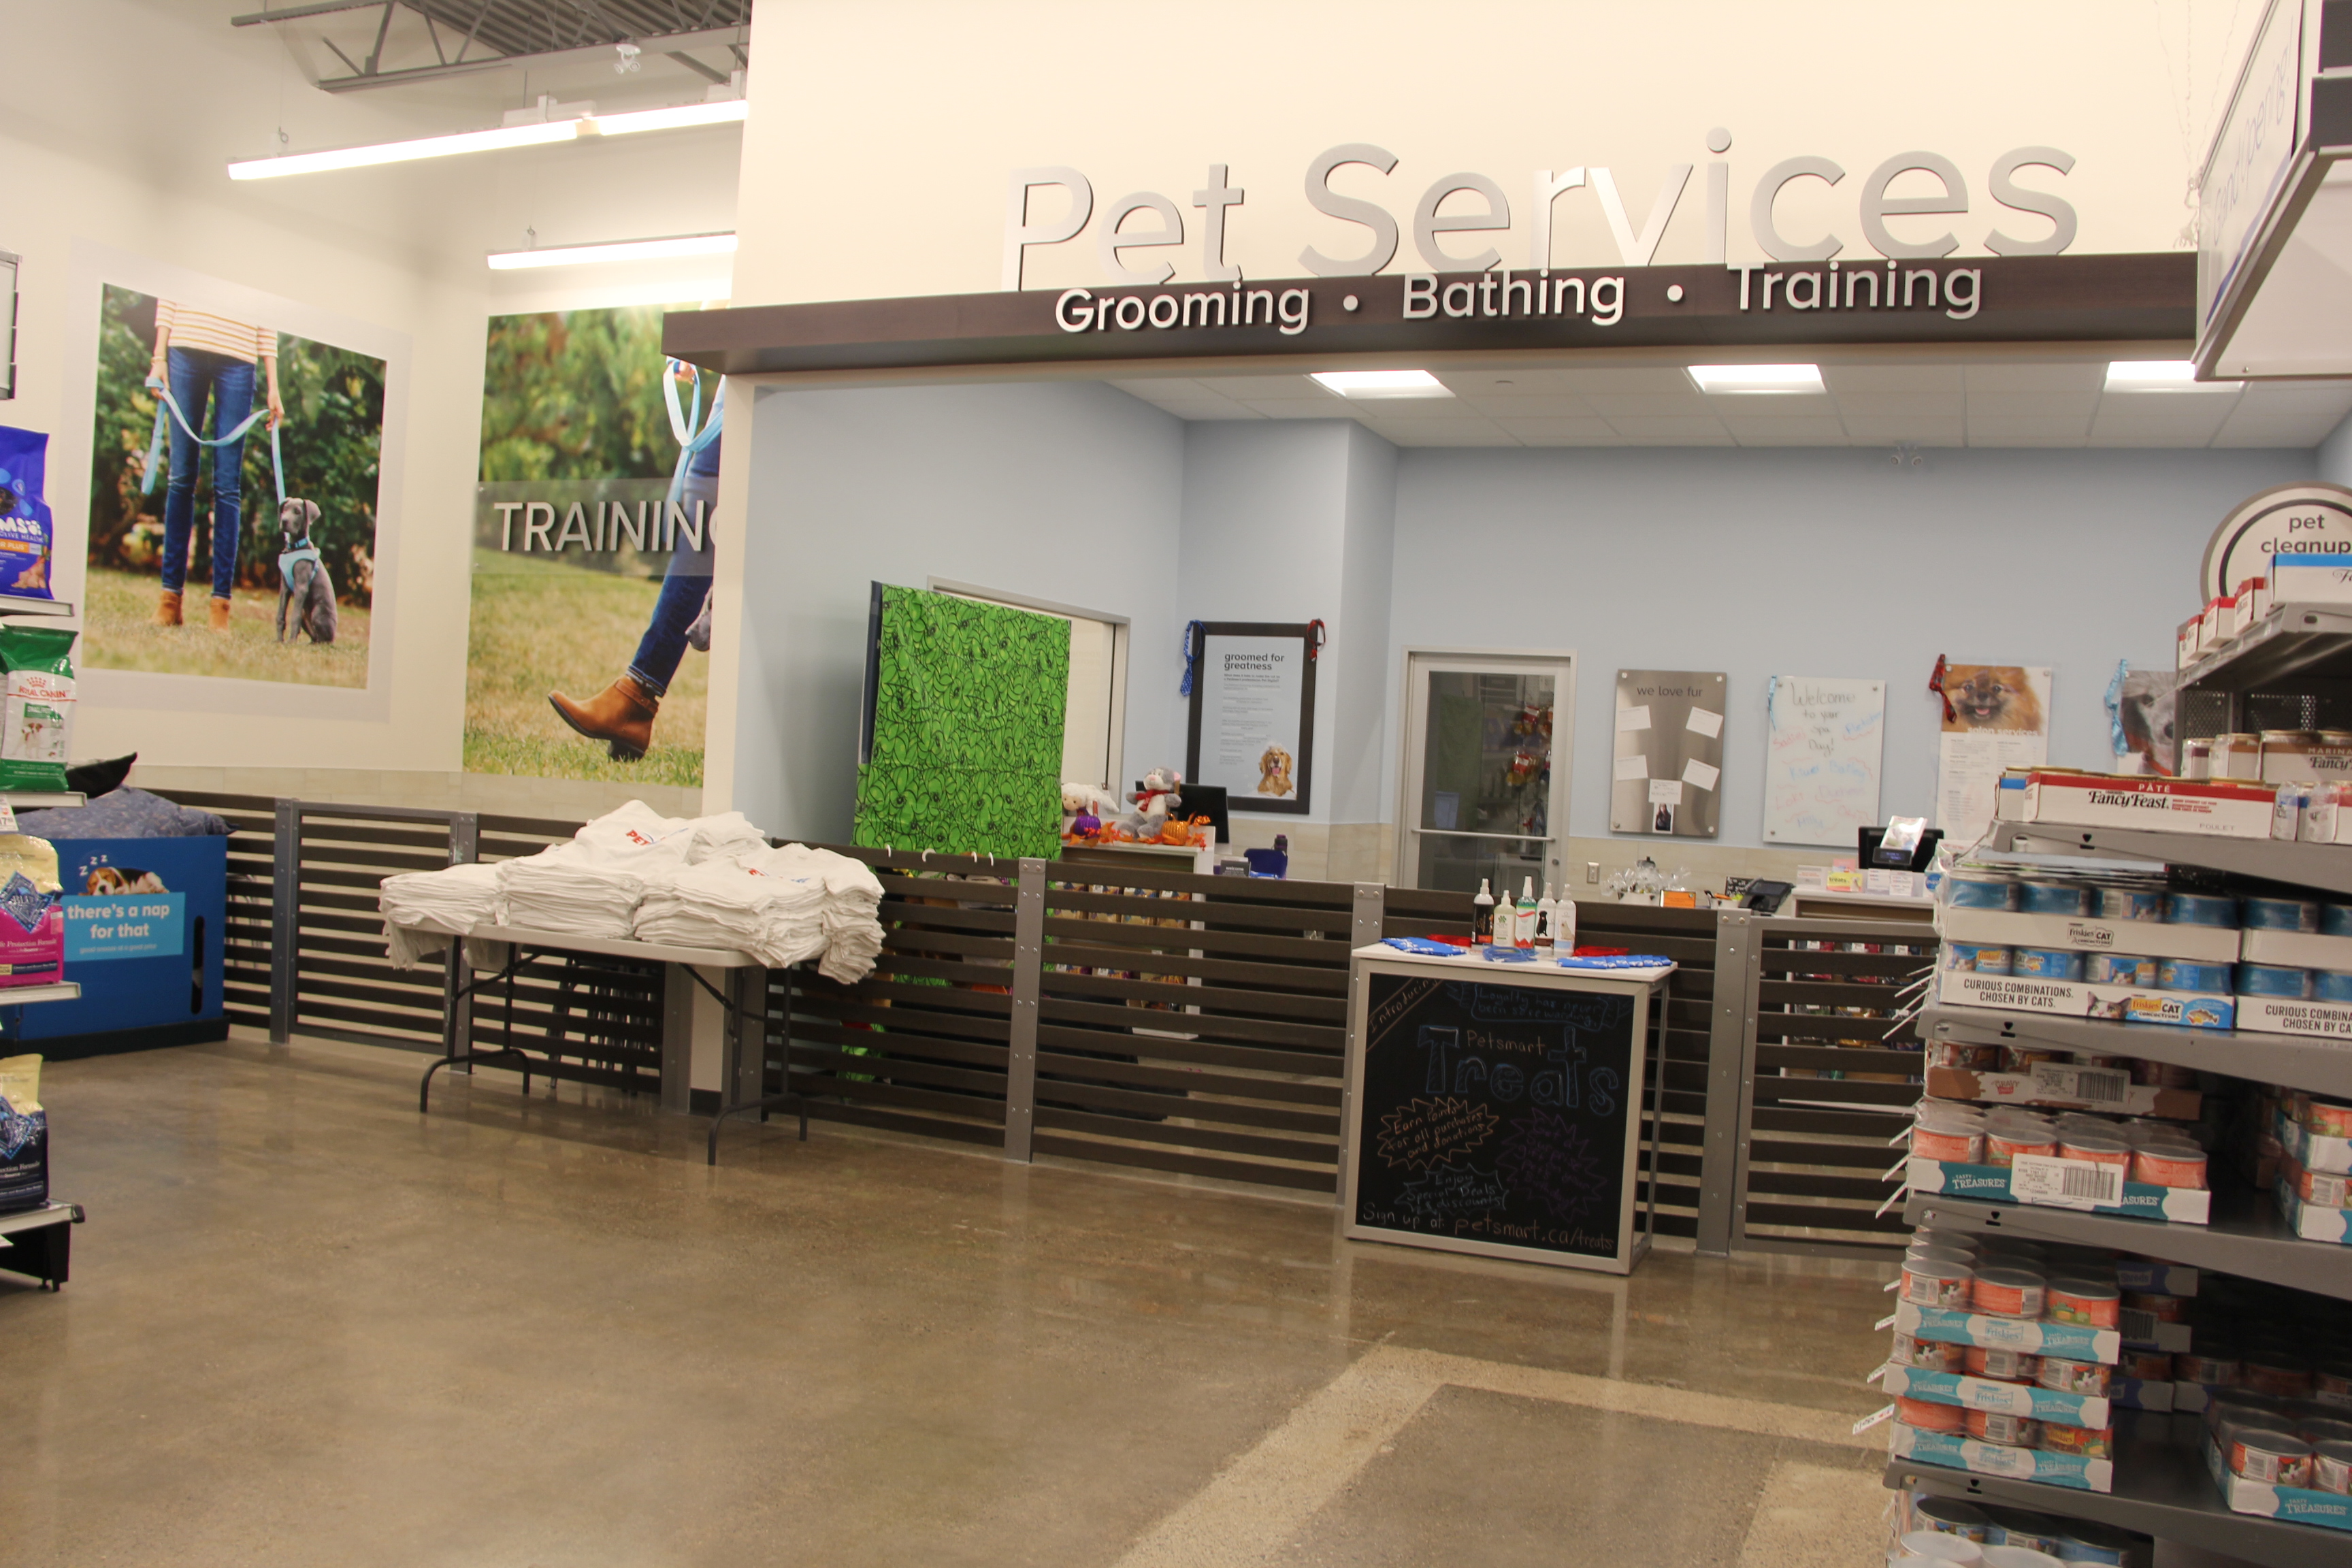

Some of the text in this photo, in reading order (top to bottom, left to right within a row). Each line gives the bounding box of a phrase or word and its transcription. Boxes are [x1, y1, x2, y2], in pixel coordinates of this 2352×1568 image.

[1002, 126, 2078, 291] Pet Services
[1056, 260, 1982, 335] Grooming Bathing Training
[2289, 514, 2325, 533] pet
[2261, 537, 2351, 555] cleanup
[1224, 653, 1284, 662] groomed for
[1224, 662, 1272, 670] greatness
[1637, 686, 1703, 697] we love fur
[1791, 683, 1856, 706] Welcome
[1803, 709, 1816, 719] to
[1809, 738, 1835, 757] Day!
[2310, 756, 2350, 770] Fancy
[2138, 783, 2171, 793] PÂTÉ
[2089, 790, 2131, 808] Fancy
[2199, 822, 2235, 831] POULET
[67, 904, 170, 919] there's a nap
[90, 923, 149, 938] for that
[2096, 932, 2111, 940] CAT
[1964, 979, 2074, 998] CURIOUS COMBINATIONS.
[1480, 987, 1529, 1008] Loyalty
[1536, 994, 1557, 1009] has
[1980, 992, 2056, 1008] CHOSEN BY CATS.
[2161, 1003, 2180, 1014] CAT
[2266, 1004, 2307, 1018] CURIOUS
[2283, 1017, 2321, 1031] CHOSEN
[2324, 1022, 2336, 1032] BY
[1418, 1024, 1619, 1116] Treats
[1394, 1117, 1422, 1135] Earn
[1415, 1128, 1429, 1143] all
[1434, 1112, 1483, 1136] purchases
[1407, 1123, 1484, 1158] and donations
[1435, 1174, 1473, 1191] Enjoy
[1952, 1178, 2005, 1188] TREASURES
[1407, 1183, 1496, 1205] Special Deals
[2122, 1196, 2158, 1205] ASURES
[1437, 1196, 1501, 1209] discounts
[1363, 1202, 1394, 1224] Sign
[1403, 1215, 1420, 1229] up
[1455, 1213, 1615, 1251] petsmart.ca/treats
[1987, 1326, 2020, 1341] Friskies
[2285, 1503, 2347, 1516] TREASURES
